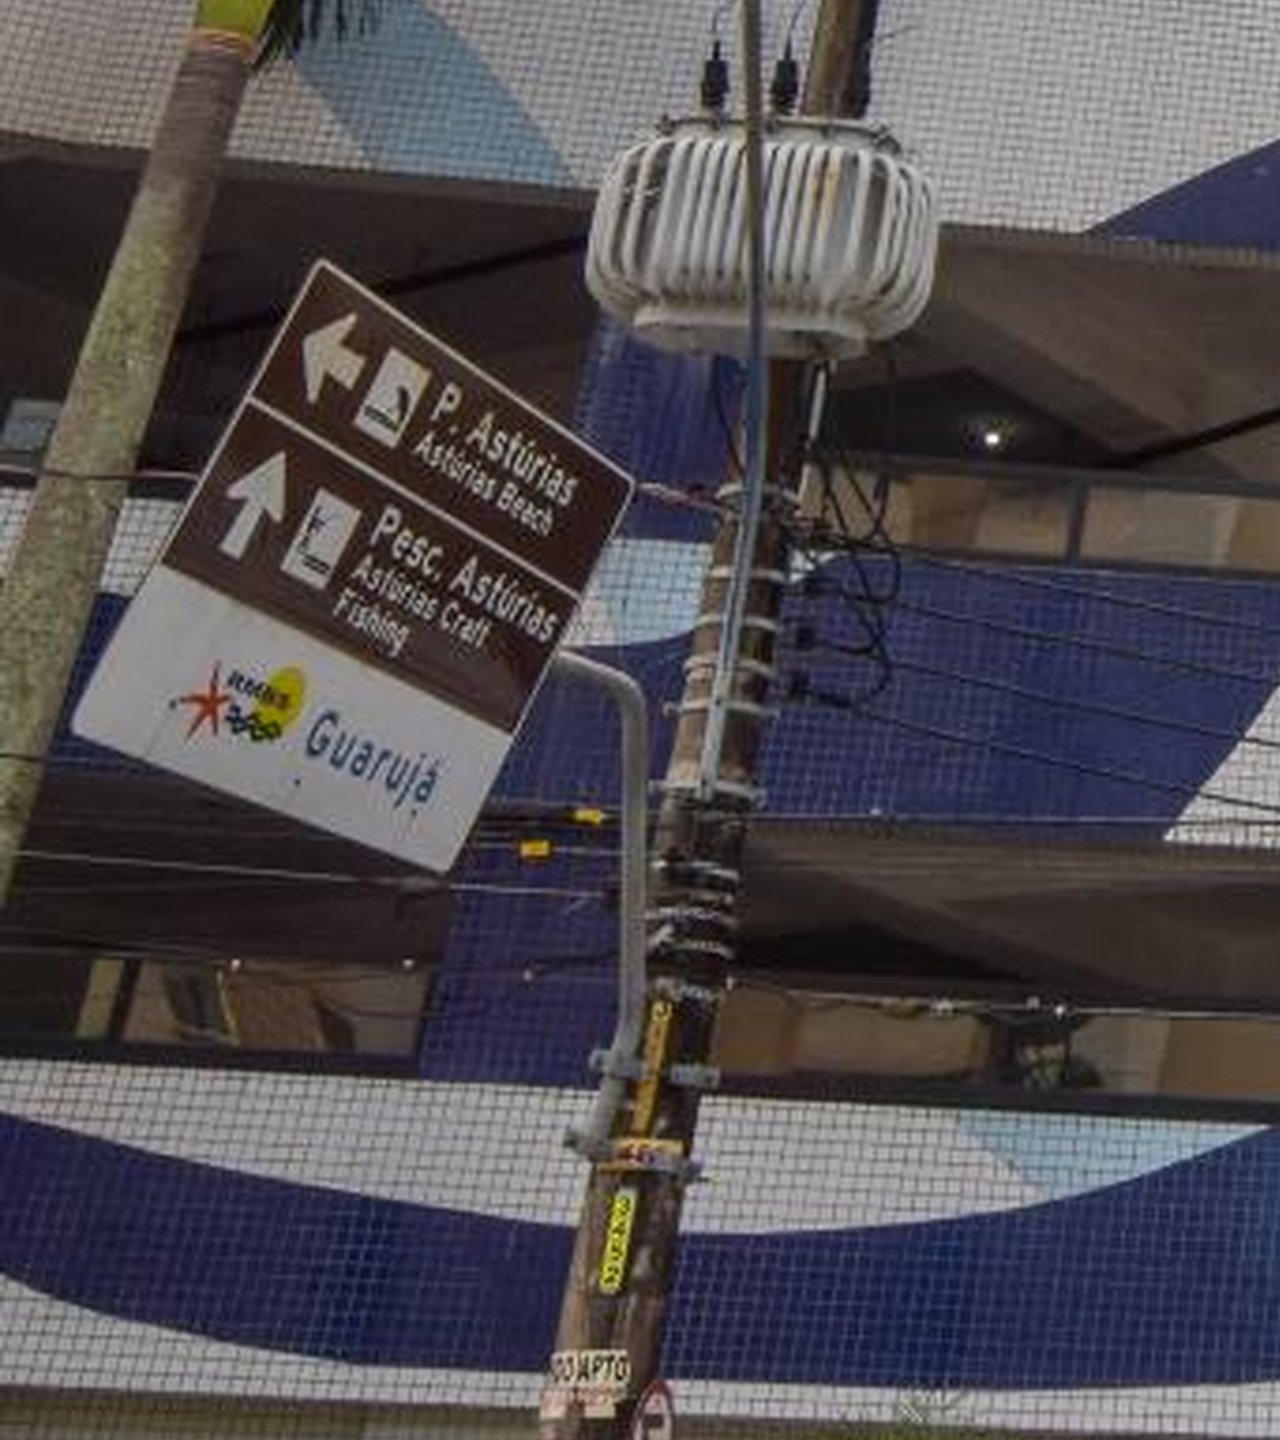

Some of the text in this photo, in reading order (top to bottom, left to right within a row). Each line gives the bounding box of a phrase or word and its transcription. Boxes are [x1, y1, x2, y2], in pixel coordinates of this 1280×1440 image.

[413, 430, 555, 536] Astúrias Beach
[465, 412, 578, 507] Astúrias
[332, 586, 411, 658] Fishing
[441, 601, 491, 648] Craft
[450, 554, 558, 643] Astúrias
[305, 710, 442, 809] Guarujá
